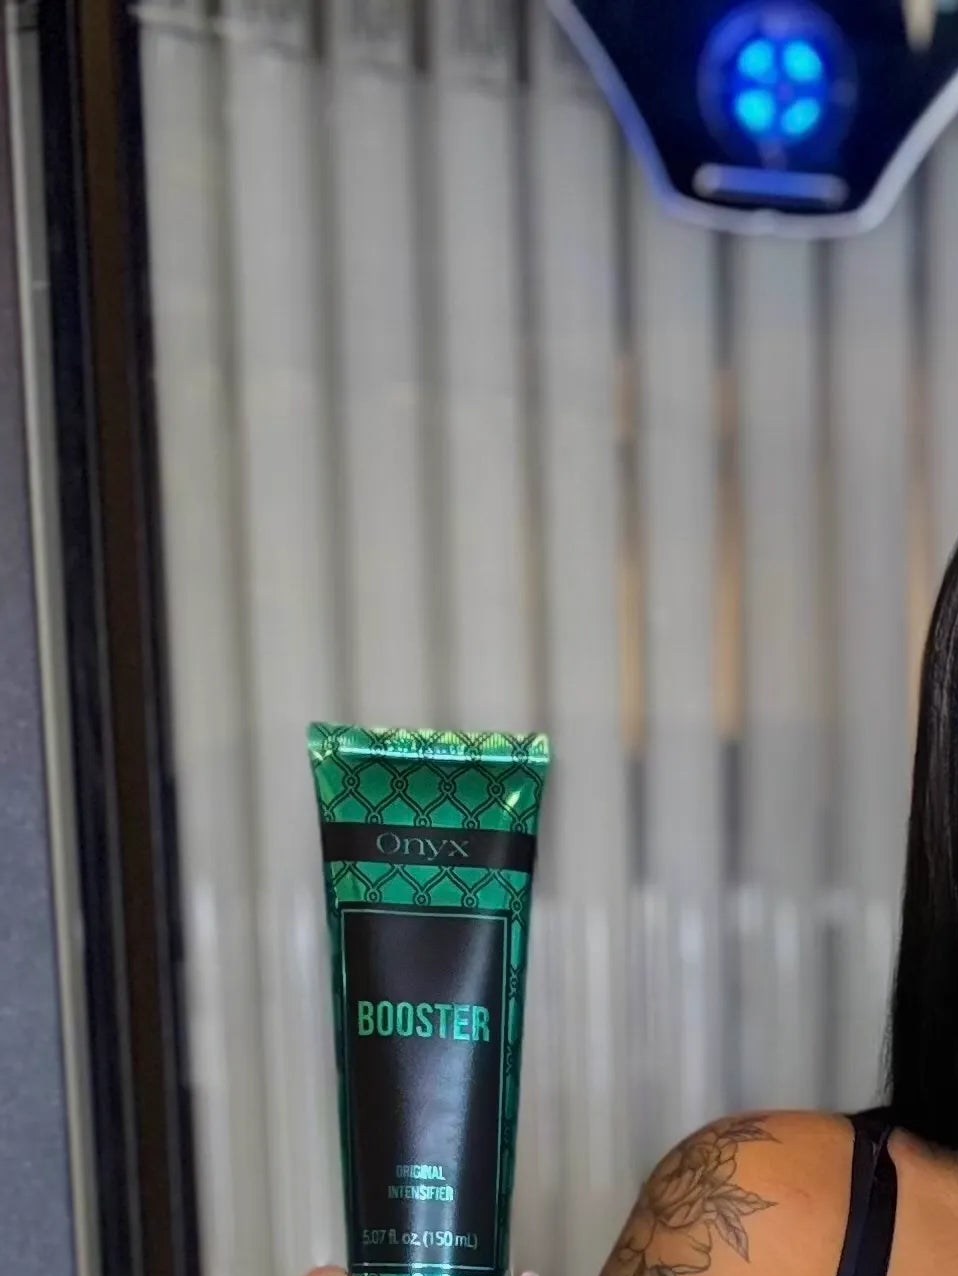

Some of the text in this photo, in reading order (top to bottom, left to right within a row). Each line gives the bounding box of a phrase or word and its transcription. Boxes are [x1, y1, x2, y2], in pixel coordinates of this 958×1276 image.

[376, 833, 470, 860] Onyx
[358, 1002, 490, 1041] BOOSTER
[396, 1165, 446, 1180] ORIGINAL
[388, 1185, 454, 1200] INTENSIFIER
[422, 1231, 453, 1247] (150
